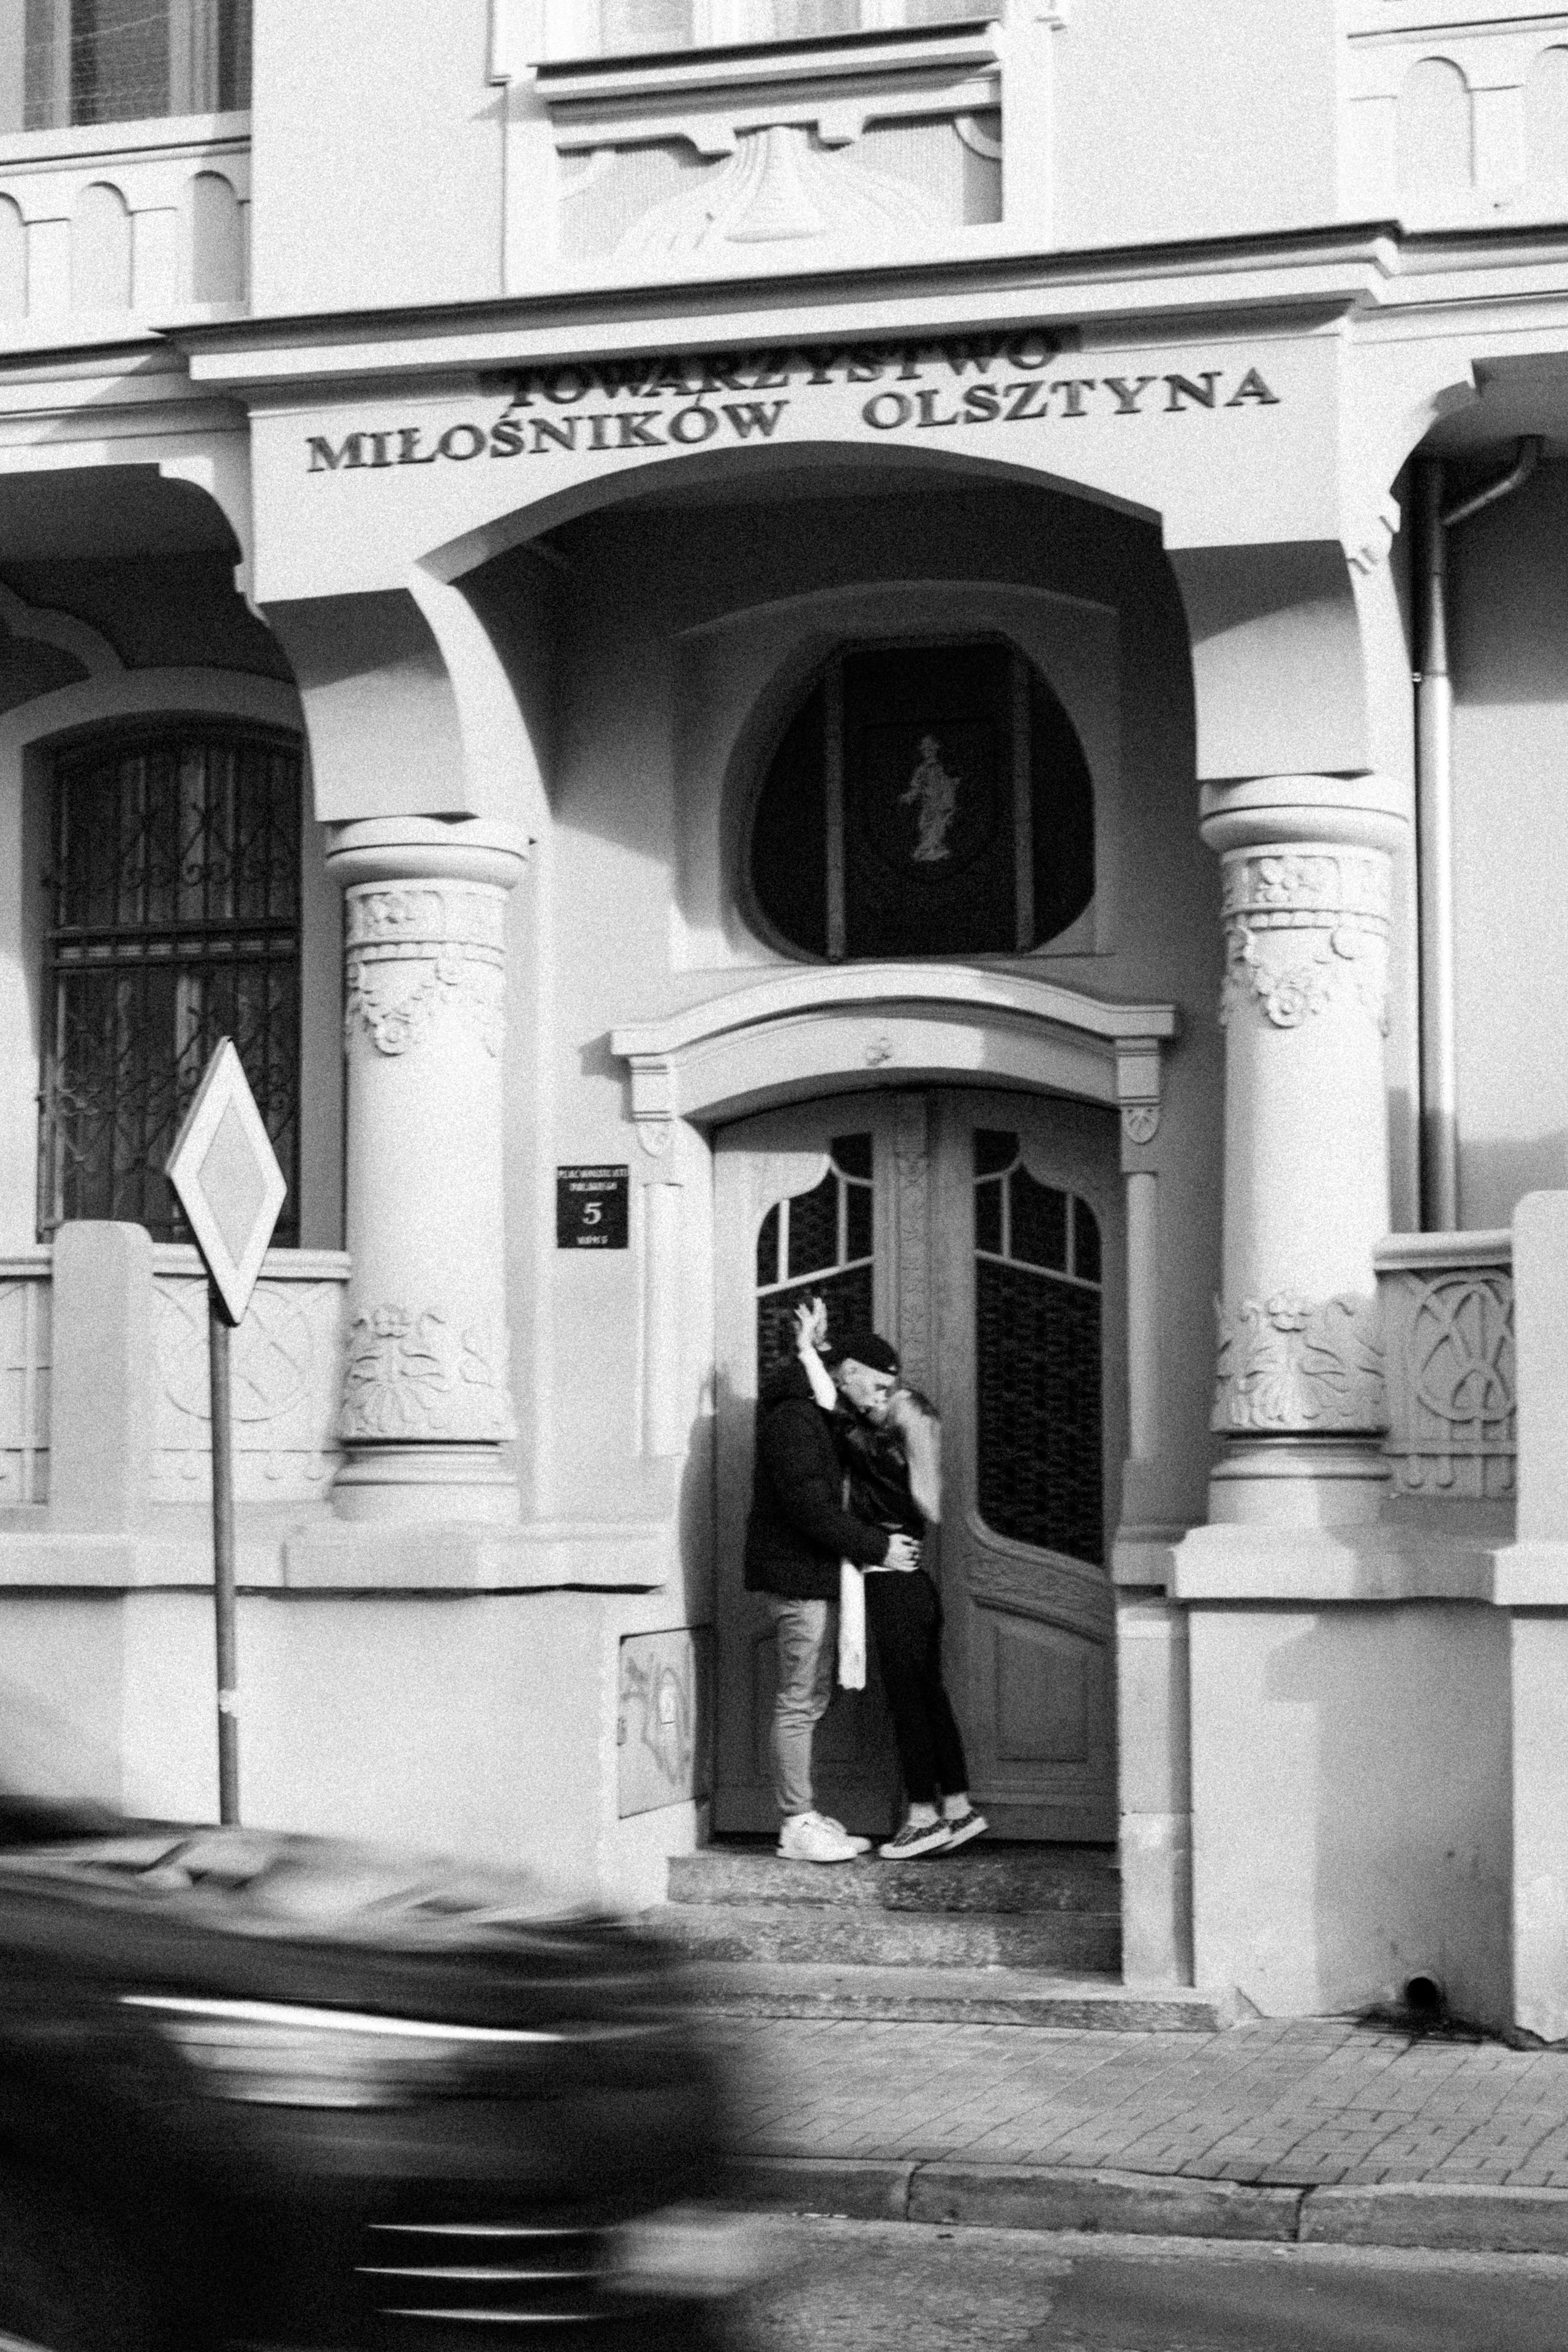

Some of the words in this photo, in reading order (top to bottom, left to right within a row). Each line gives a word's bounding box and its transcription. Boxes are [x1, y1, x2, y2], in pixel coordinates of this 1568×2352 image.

[307, 393, 790, 472] MIŁOŚNIKÓW
[861, 367, 1281, 429] OLSZTYNA
[582, 1202, 603, 1224] 5
